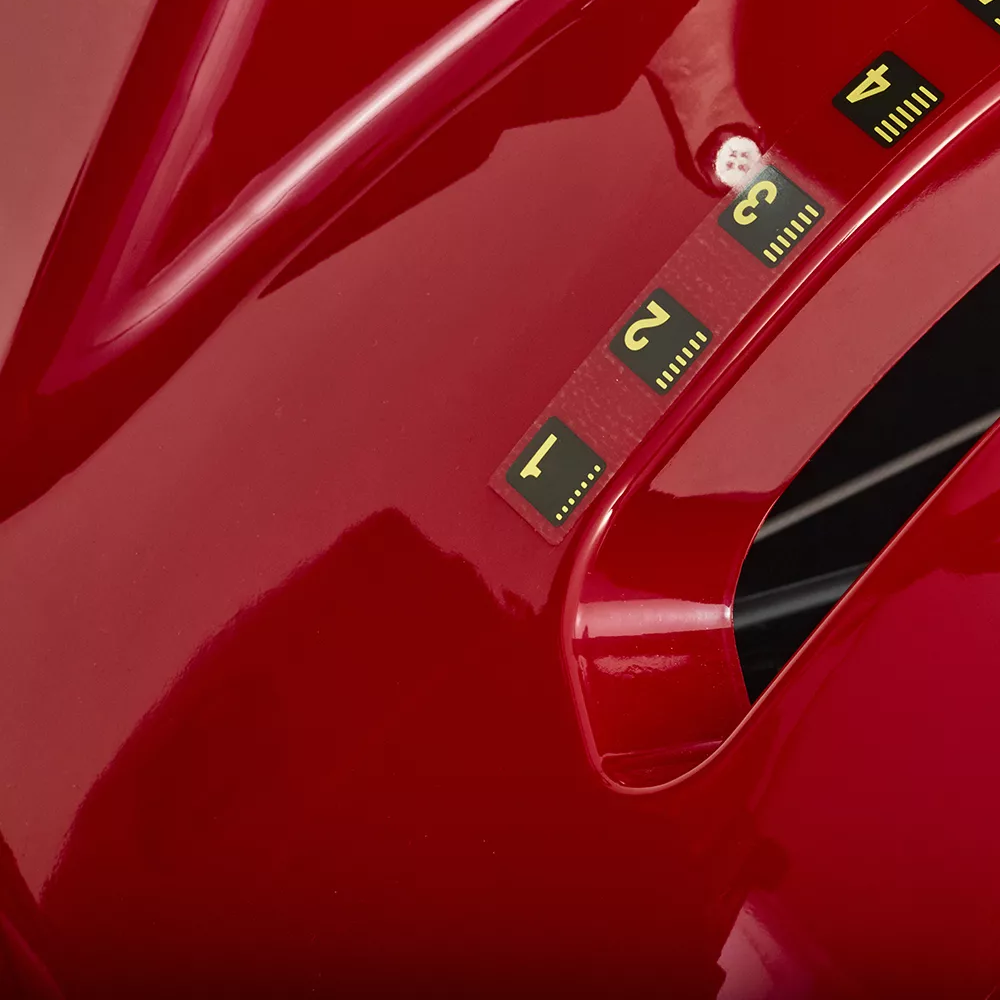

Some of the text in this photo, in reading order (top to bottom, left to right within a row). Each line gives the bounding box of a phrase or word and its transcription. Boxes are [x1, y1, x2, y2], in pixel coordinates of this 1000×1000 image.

[845, 63, 891, 104] 4
[732, 180, 778, 226] 3
[623, 300, 671, 351] 2
[519, 433, 558, 479] 1
